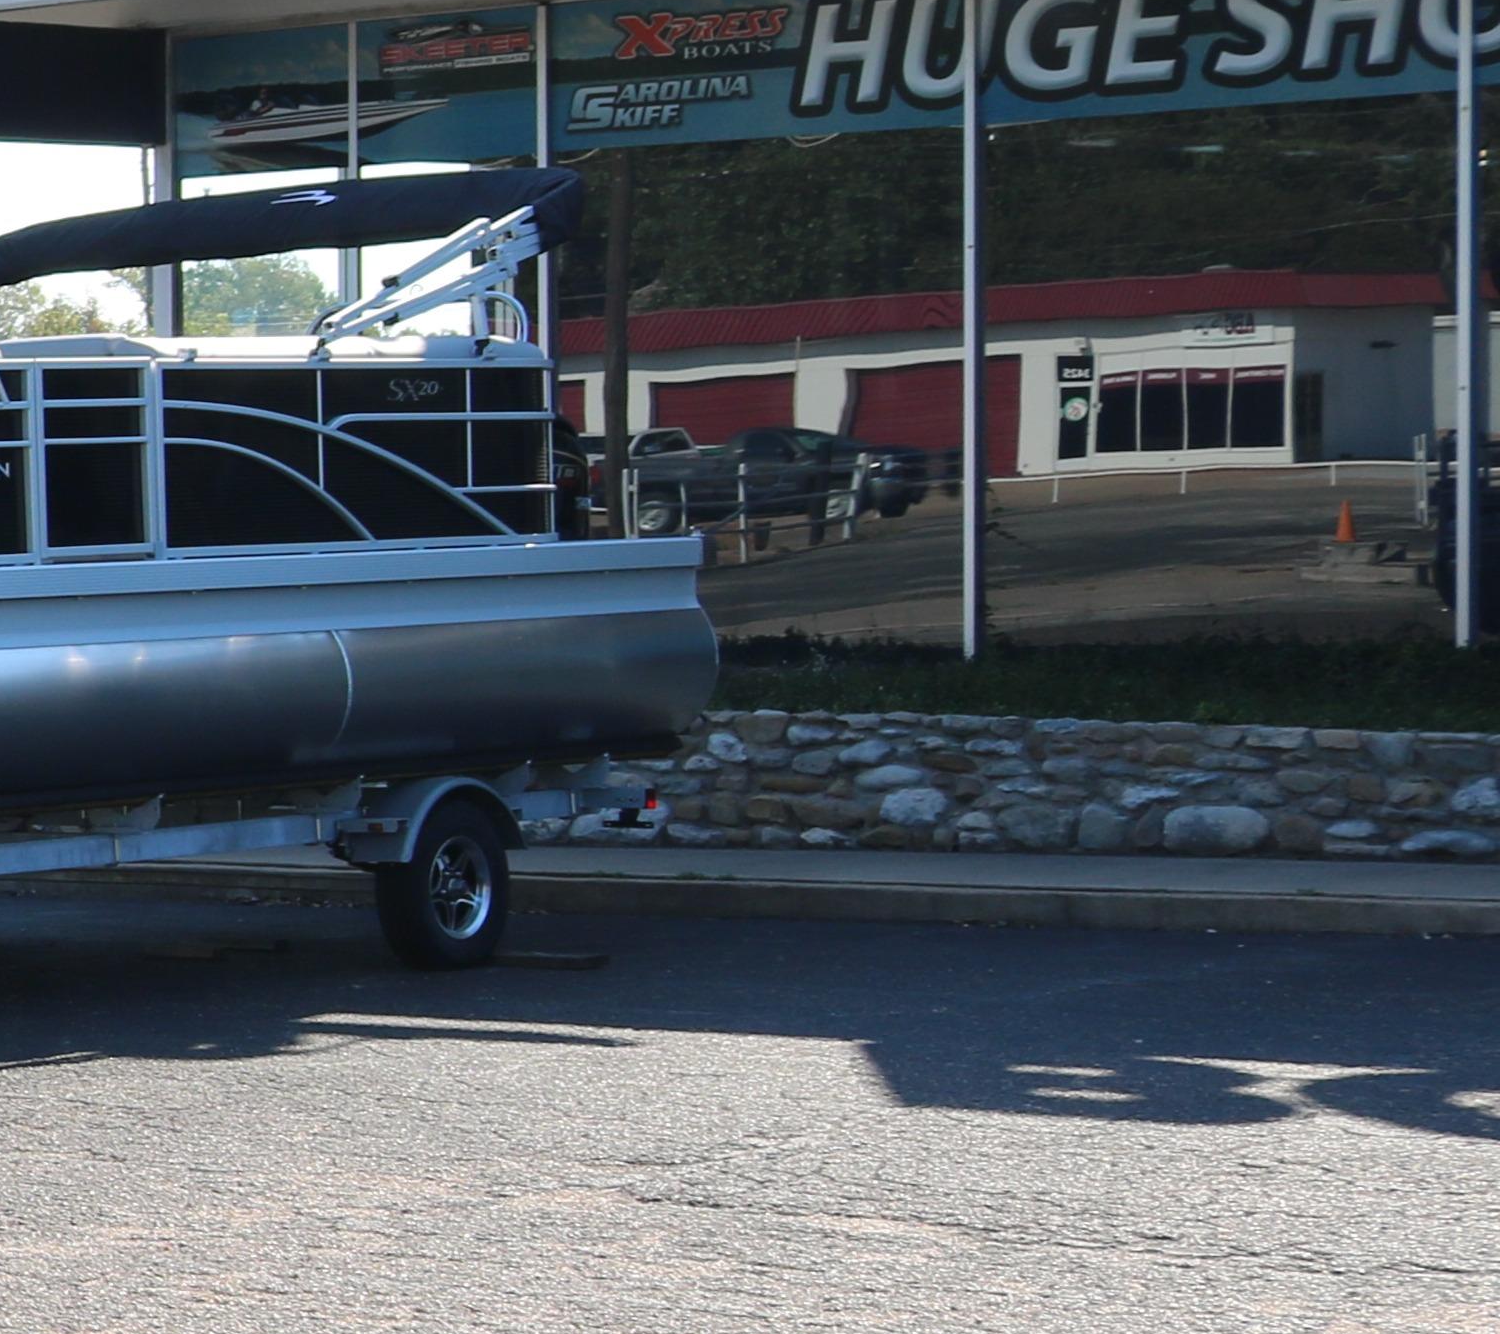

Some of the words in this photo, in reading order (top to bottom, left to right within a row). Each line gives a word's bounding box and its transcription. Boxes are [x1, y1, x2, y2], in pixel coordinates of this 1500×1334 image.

[614, 8, 789, 60] XPRESS
[683, 40, 772, 60] BOATS
[566, 98, 681, 130] SKIFF
[571, 76, 749, 119] CAROLINA
